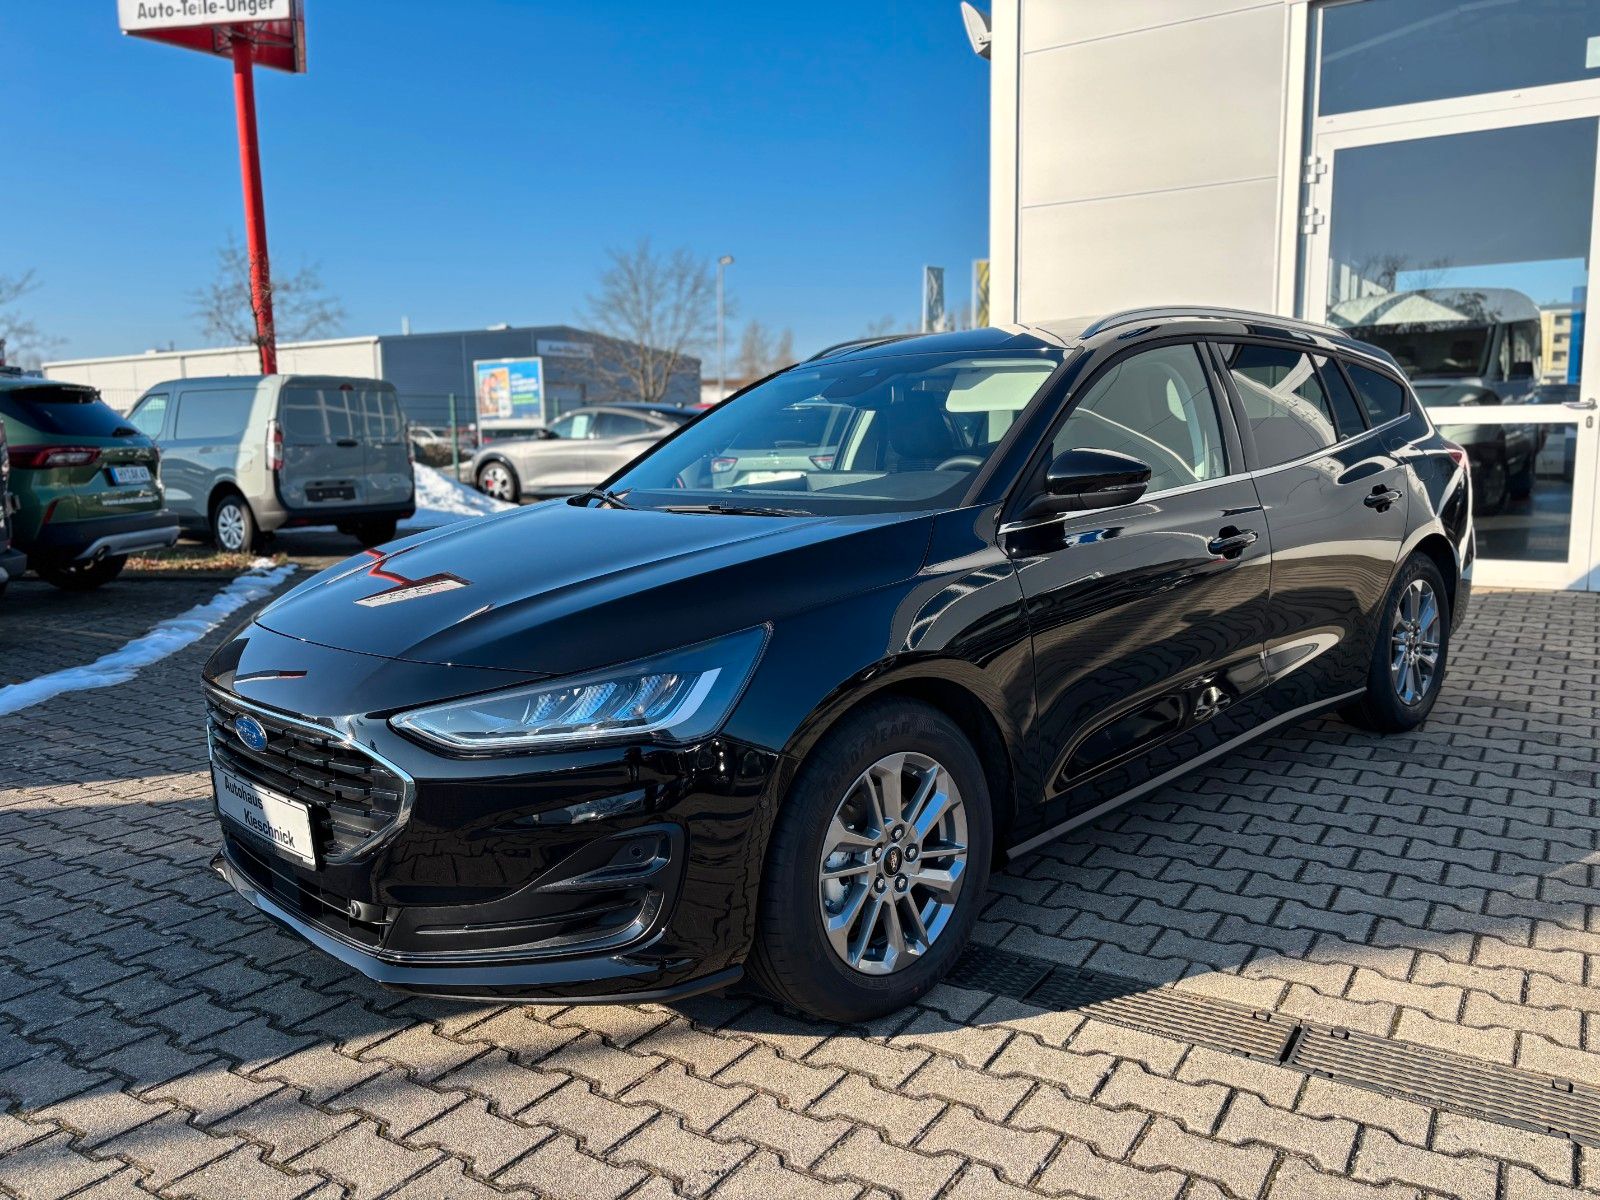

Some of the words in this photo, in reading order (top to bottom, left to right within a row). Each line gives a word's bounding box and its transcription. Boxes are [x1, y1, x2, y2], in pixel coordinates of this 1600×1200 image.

[137, 0, 274, 19] Auto-Teile-Unger
[224, 776, 264, 810] Autohaus
[243, 808, 296, 849] Kieschnick
